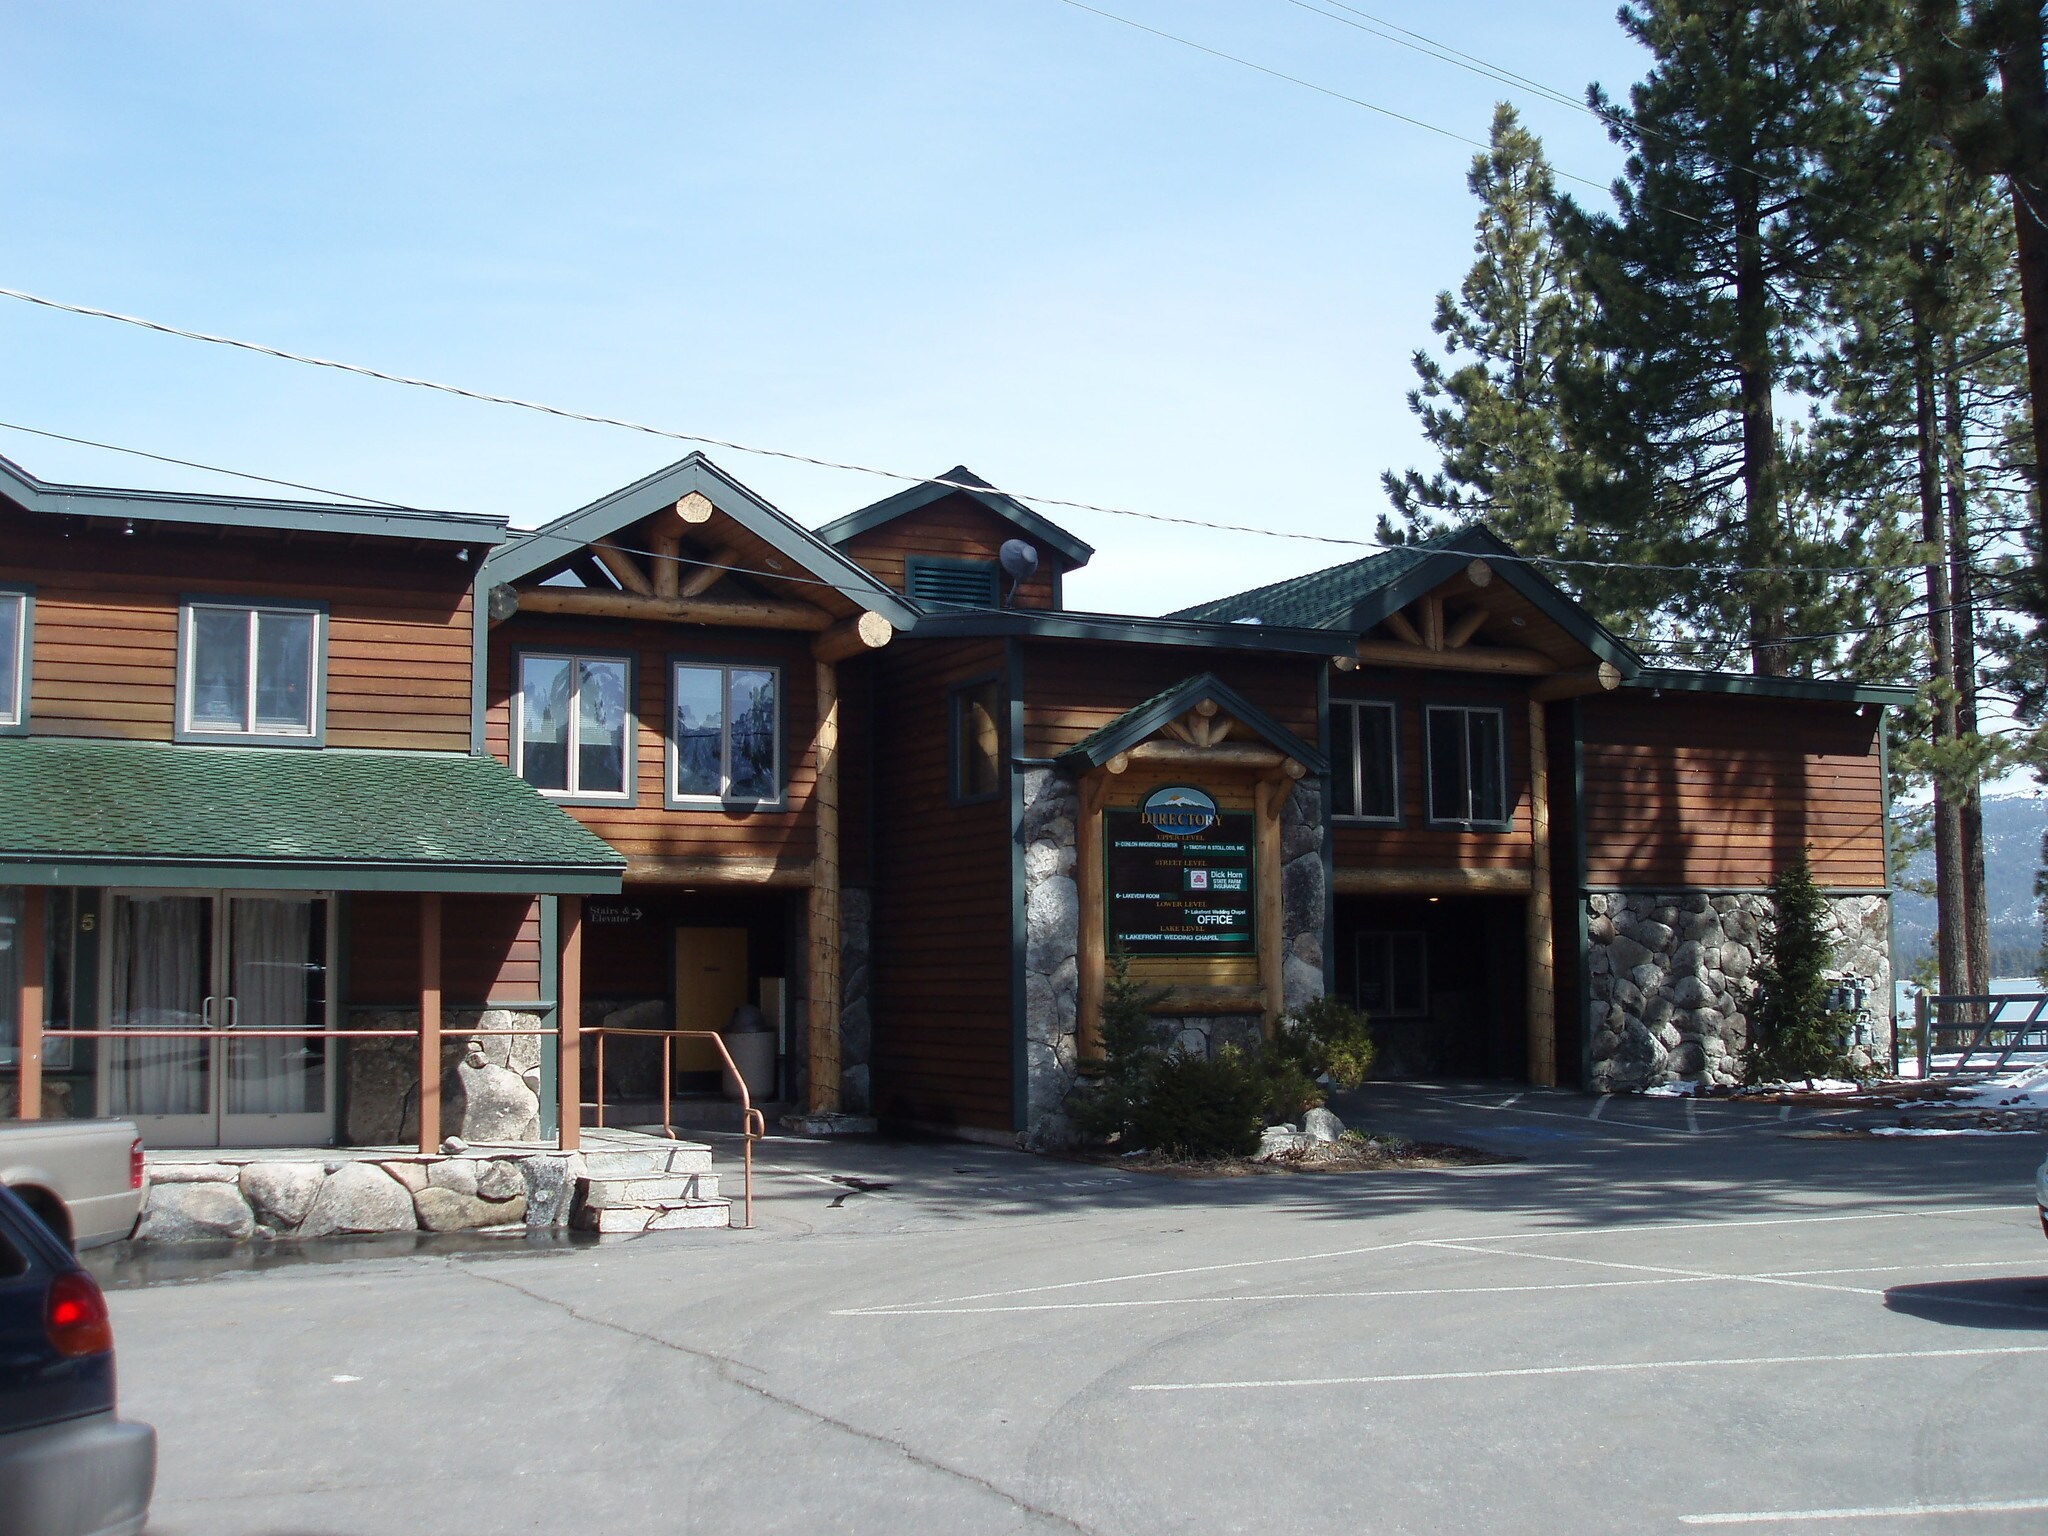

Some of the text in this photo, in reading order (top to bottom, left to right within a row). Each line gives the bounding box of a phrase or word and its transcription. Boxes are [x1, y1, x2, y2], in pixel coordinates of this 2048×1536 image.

[1141, 812, 1223, 826] DIRECTORY
[1155, 859, 1207, 867] STREET LEVEL
[1211, 871, 1225, 879] Dick
[1227, 871, 1243, 879] Horn
[590, 906, 630, 915] Stairs &
[81, 913, 96, 931] 5
[591, 914, 630, 922] Elevator
[1197, 915, 1233, 925] OFFICE
